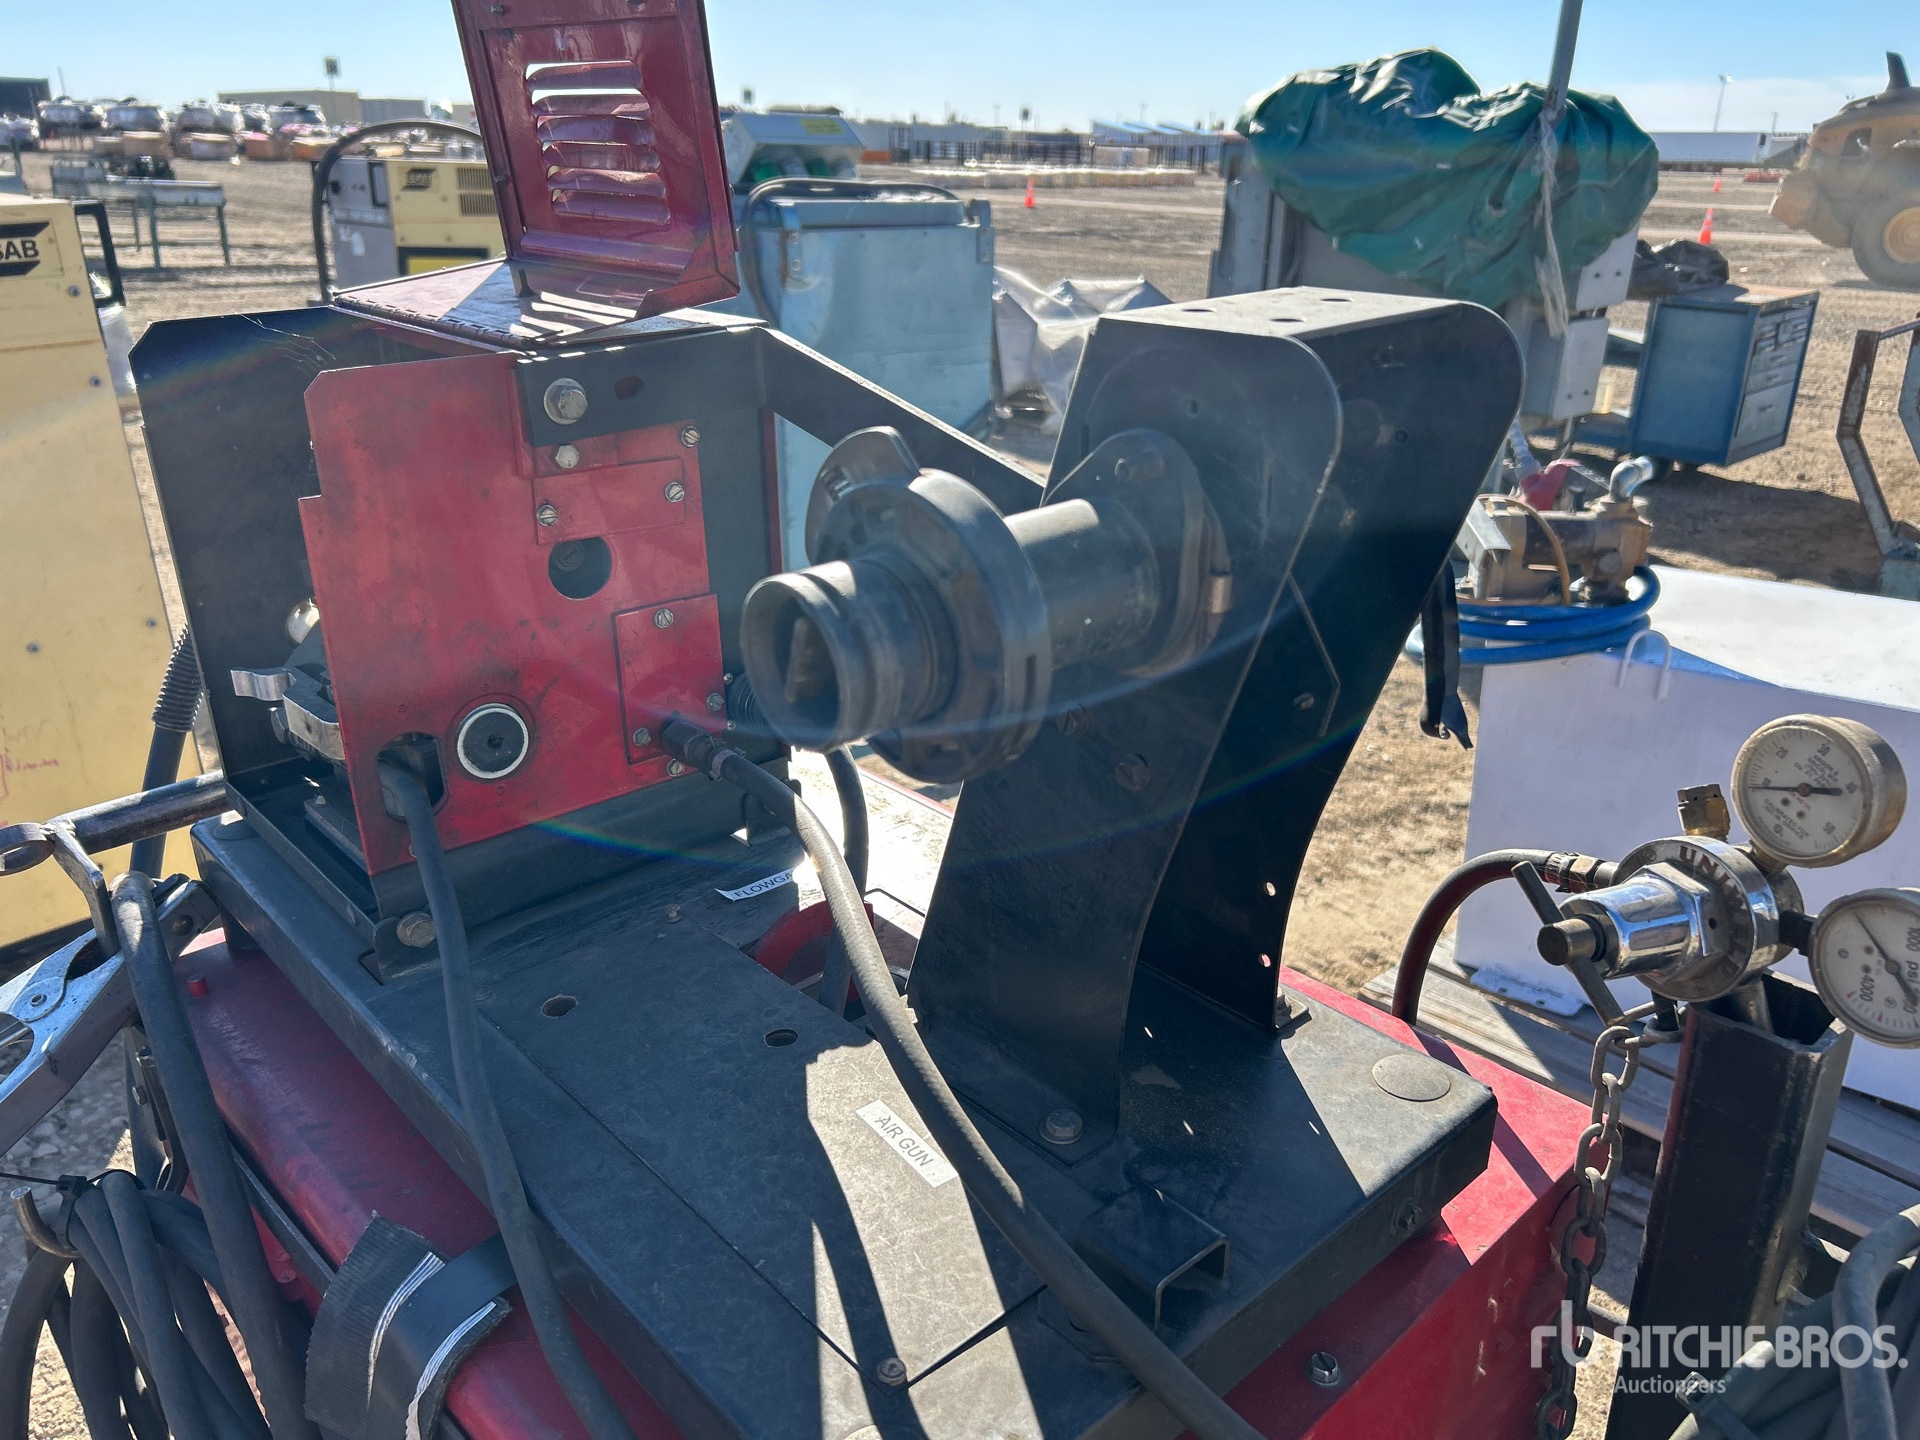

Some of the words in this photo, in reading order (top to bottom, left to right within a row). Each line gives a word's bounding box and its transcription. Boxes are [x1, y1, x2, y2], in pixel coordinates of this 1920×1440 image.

[0, 240, 39, 259] AB
[1775, 746, 1788, 759] 20
[1859, 974, 1875, 1002] 4000
[874, 1115, 904, 1139] AIR
[898, 1137, 934, 1167] GUN
